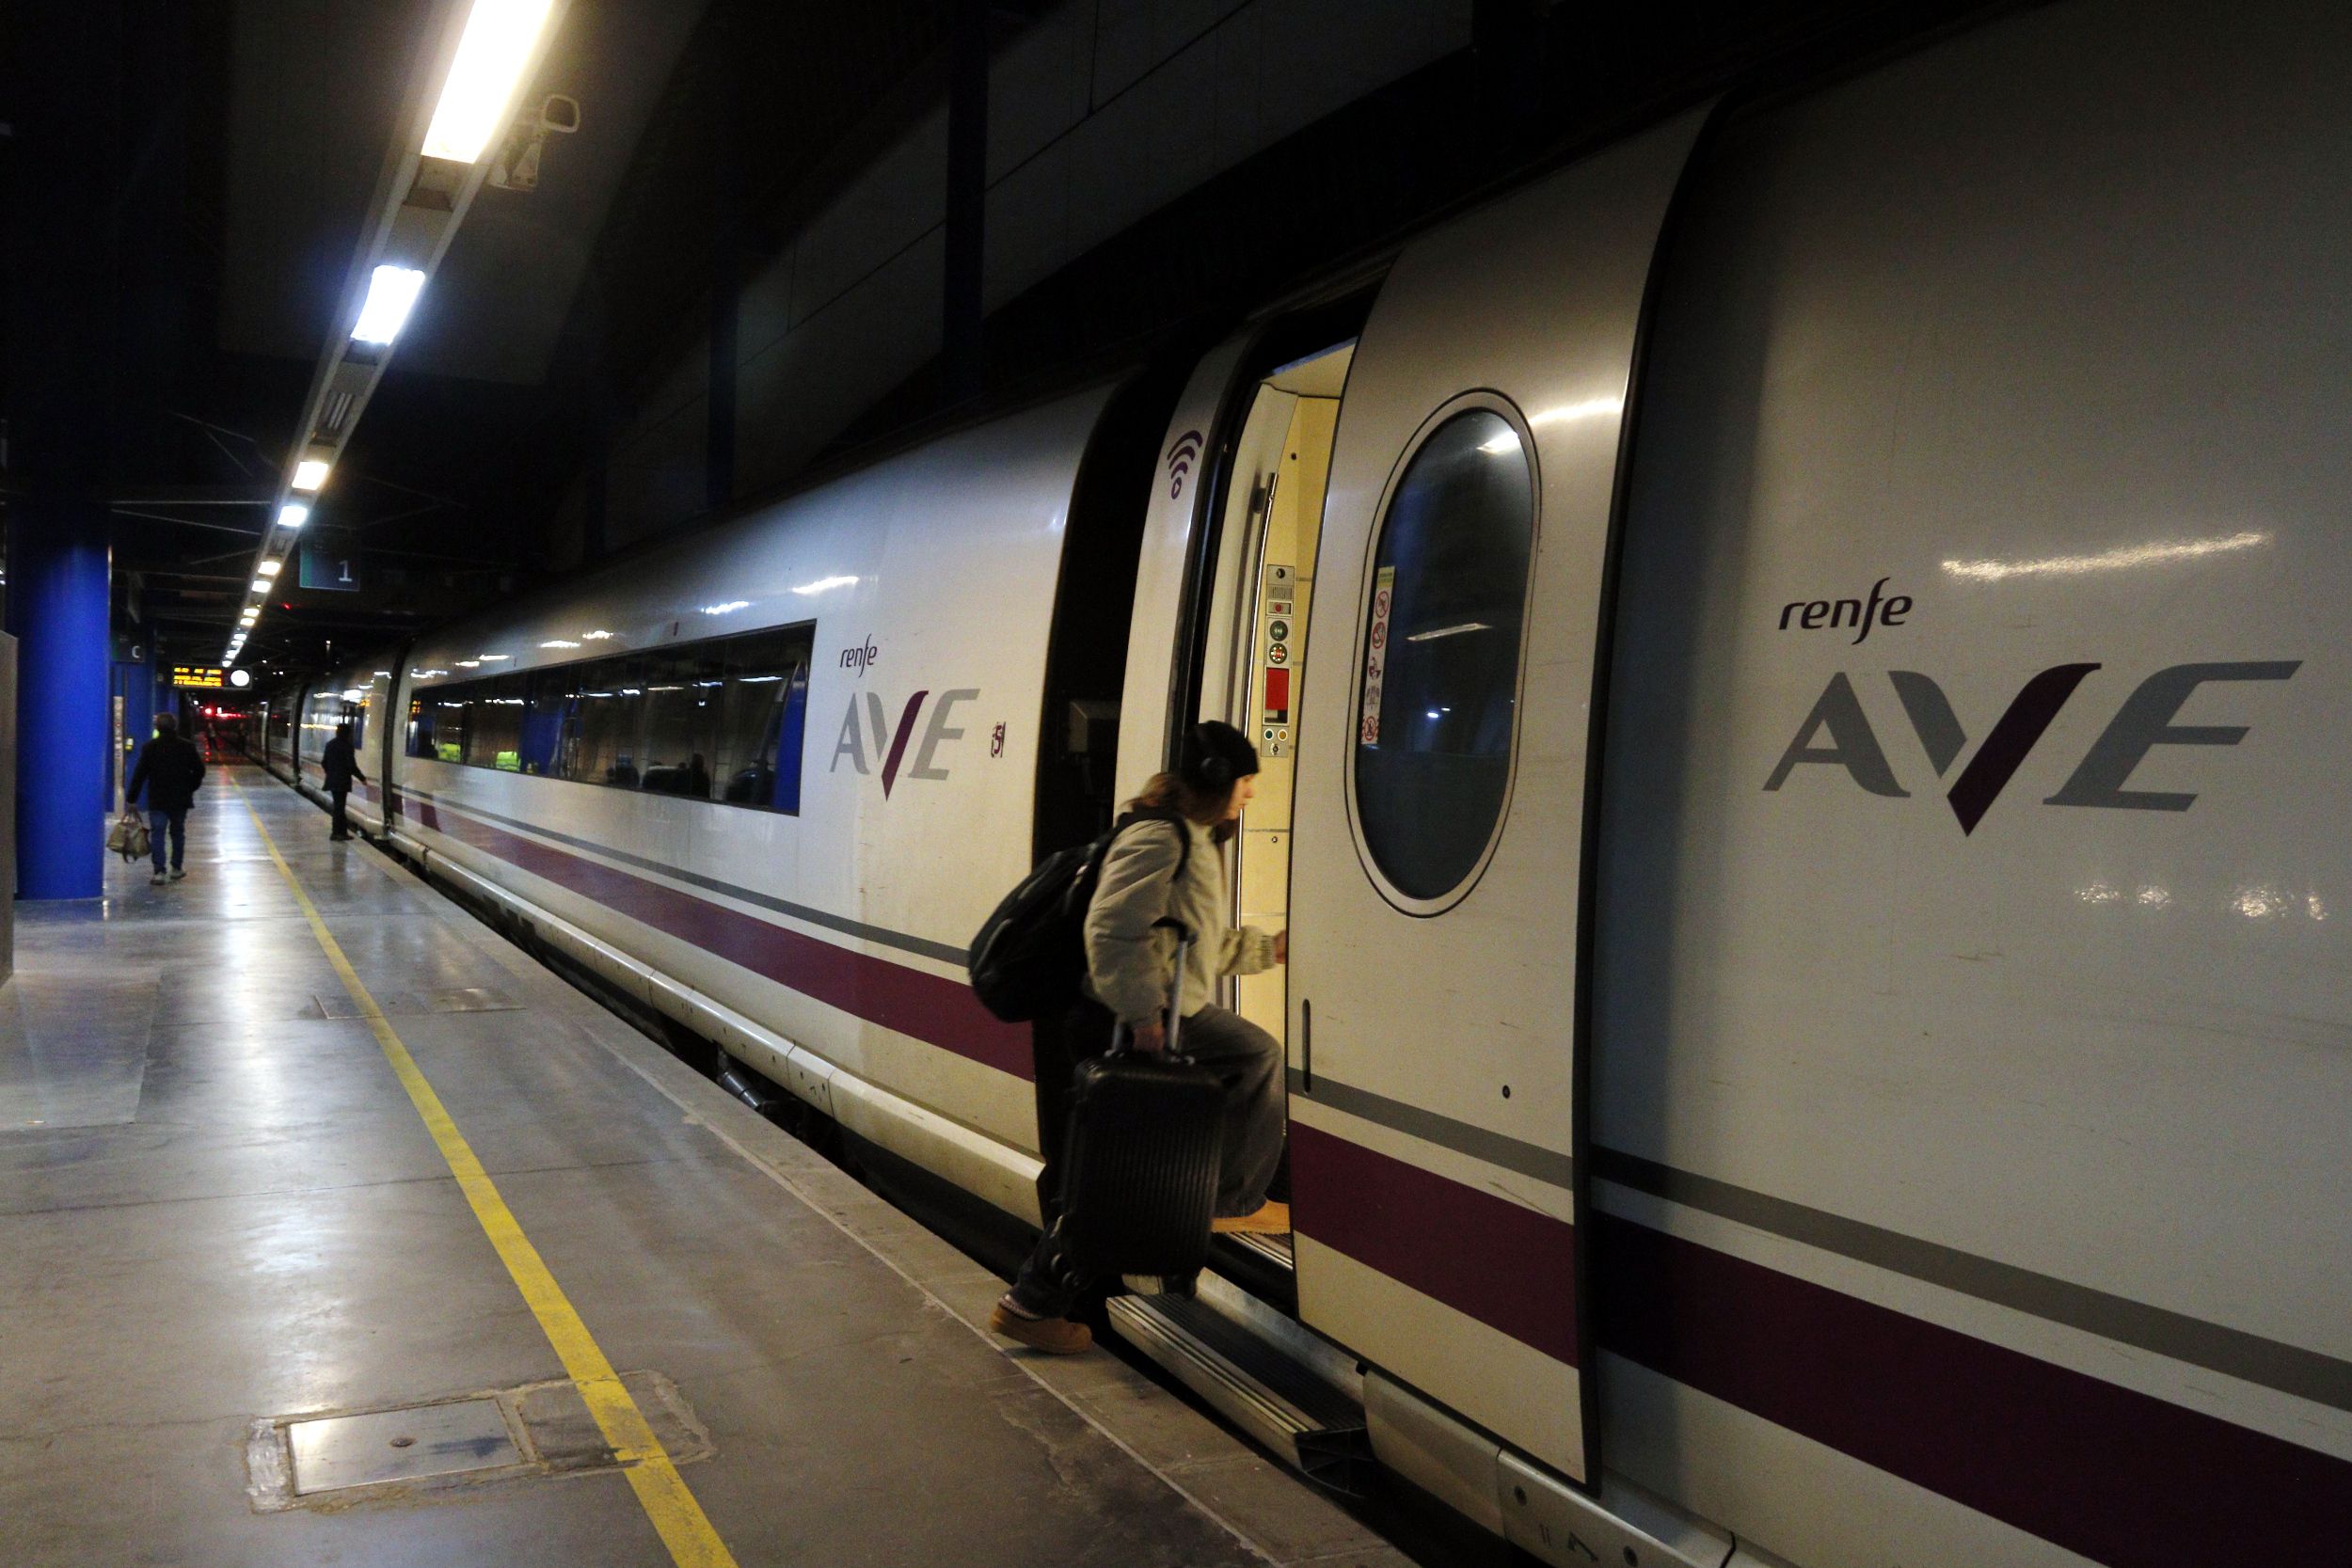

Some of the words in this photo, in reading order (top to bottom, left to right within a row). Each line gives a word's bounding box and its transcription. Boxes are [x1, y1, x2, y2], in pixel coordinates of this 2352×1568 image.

[338, 560, 353, 582] 1
[1778, 576, 1914, 645] renfe
[839, 633, 878, 678] renfe
[829, 688, 981, 802] AVE
[1762, 660, 2303, 838] AVE
